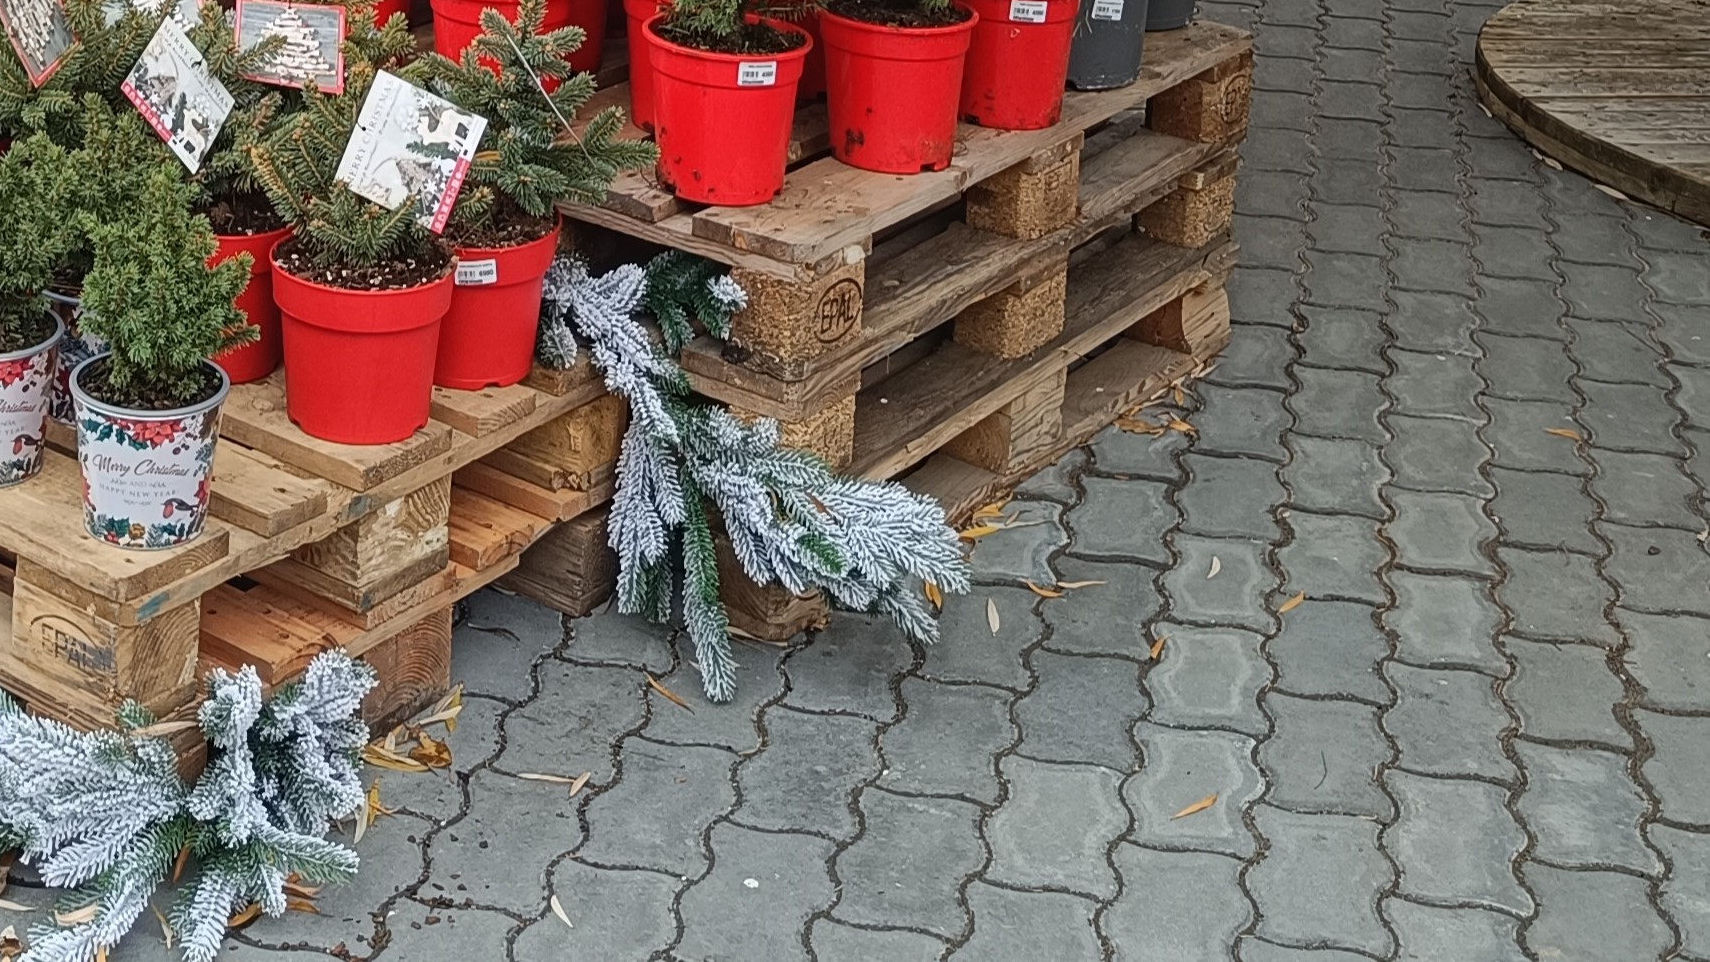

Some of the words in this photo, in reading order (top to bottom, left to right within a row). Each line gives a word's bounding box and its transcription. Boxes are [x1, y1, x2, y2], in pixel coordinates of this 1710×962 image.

[163, 24, 190, 57] MERRY
[363, 79, 395, 146] CHRISTMAS
[820, 291, 854, 335] EPAL
[92, 454, 131, 477] Merry
[134, 459, 190, 477] Christmas
[99, 483, 126, 494] HAPPY
[129, 490, 150, 498] NEW
